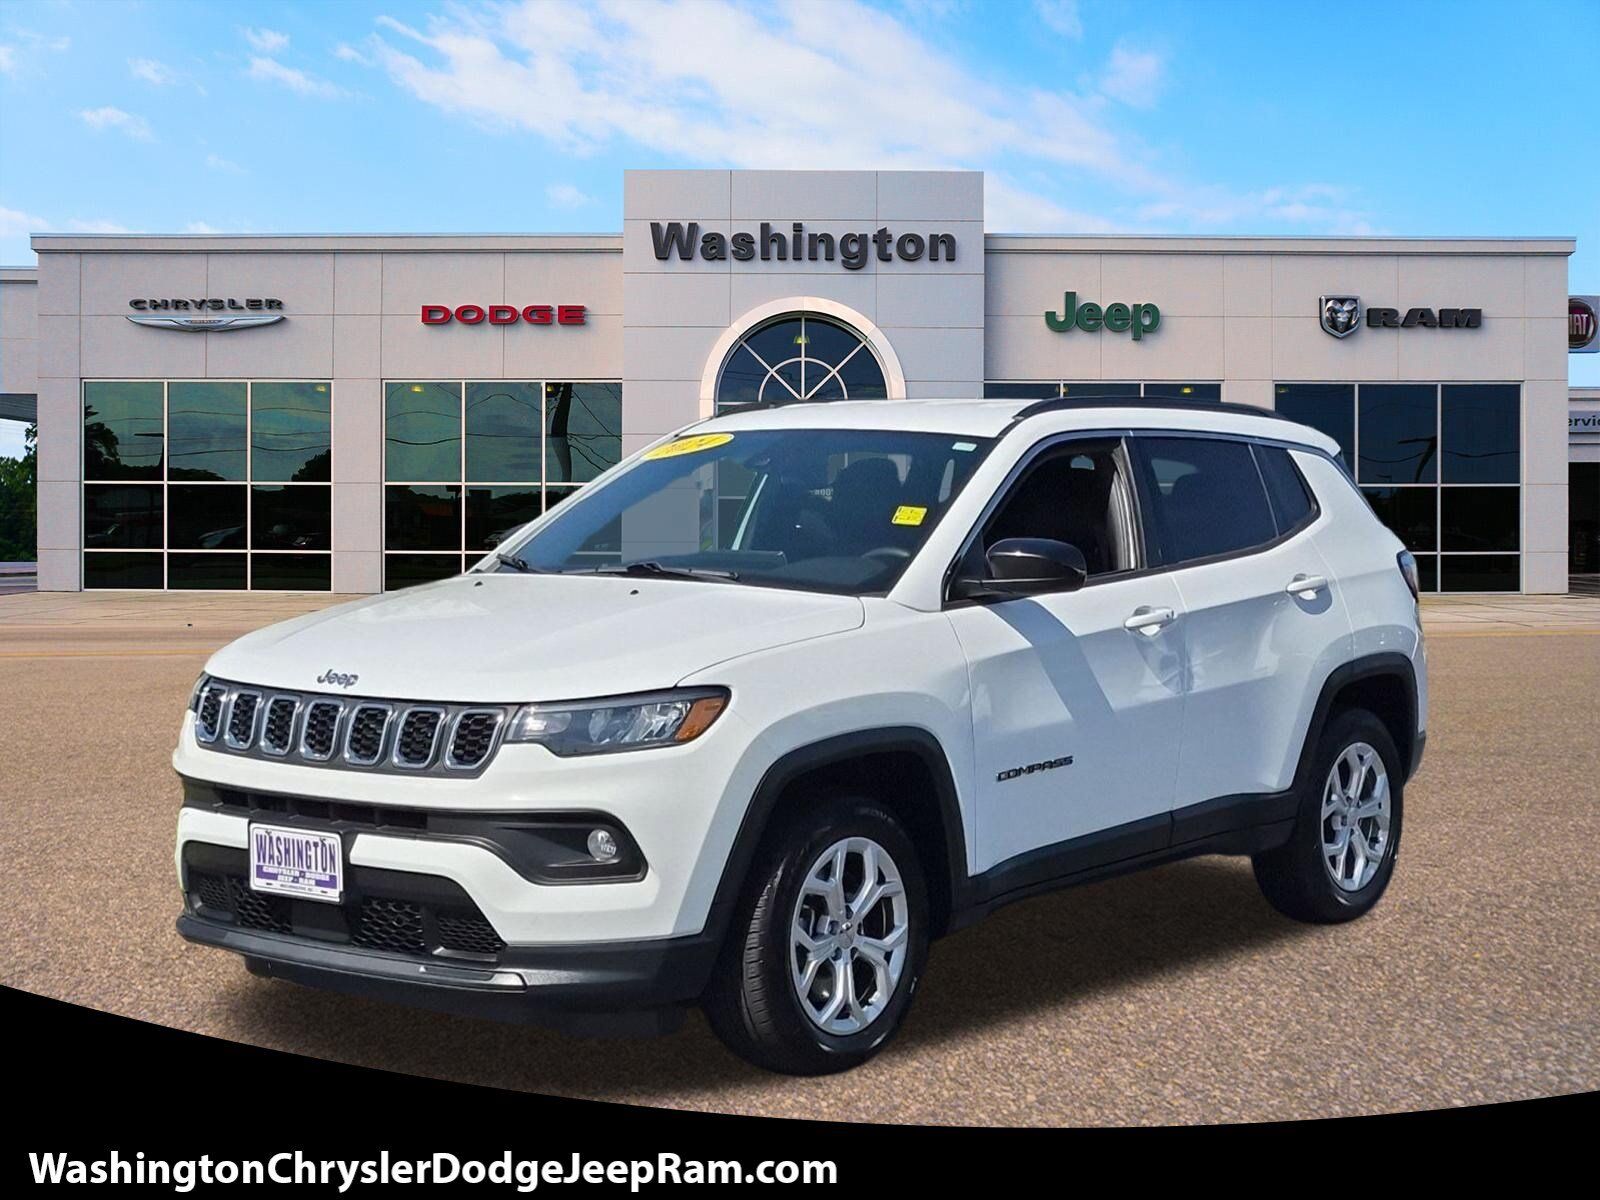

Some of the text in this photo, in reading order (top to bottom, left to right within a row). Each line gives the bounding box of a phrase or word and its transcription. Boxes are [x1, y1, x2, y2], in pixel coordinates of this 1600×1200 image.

[649, 222, 957, 270] Washington
[129, 299, 284, 310] CHRYSLER
[421, 304, 588, 325] DODGE
[1045, 291, 1161, 341] Jeep
[1366, 307, 1482, 328] RAM
[1568, 314, 1588, 335] IAT
[316, 669, 359, 689] Jeep
[996, 755, 1074, 782] COMPASS
[255, 833, 336, 874] WASHINGTON
